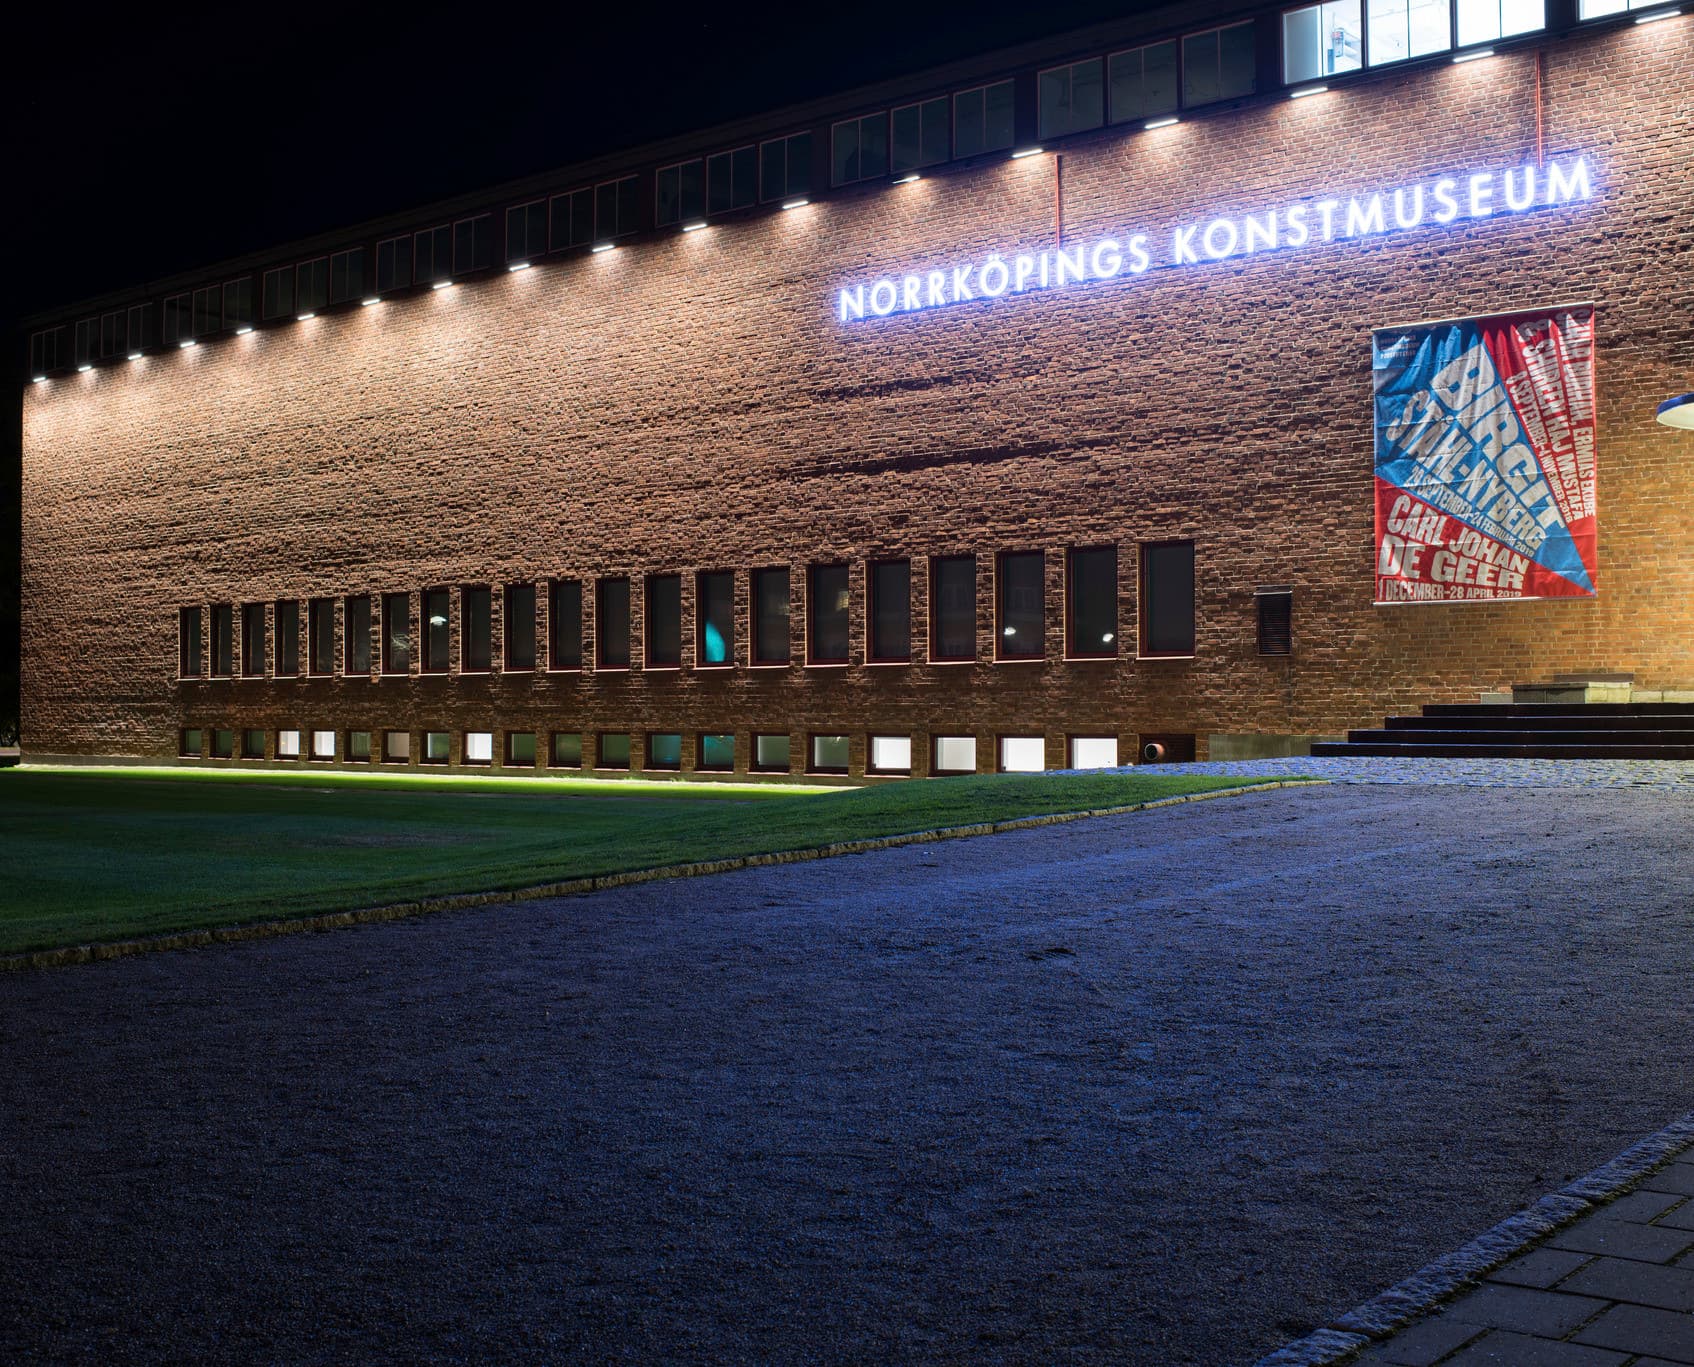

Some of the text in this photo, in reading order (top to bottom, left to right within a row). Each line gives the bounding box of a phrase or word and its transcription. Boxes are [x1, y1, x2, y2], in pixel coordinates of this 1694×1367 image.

[840, 160, 1591, 321] NORRKÖPINGS KONSTMUSEUM
[1522, 339, 1568, 418] SHIREEN
[1431, 343, 1566, 528] BIRGIT
[1545, 415, 1573, 452] HAJ
[1573, 426, 1595, 479] ERMIAS
[1386, 389, 1546, 550] STÅHL-NYBERG
[1540, 455, 1565, 501] NOVEMBER
[1556, 453, 1585, 520] MUSTAFA
[1581, 480, 1596, 517] EKUBE
[1378, 533, 1523, 590] DE GEER
[1387, 495, 1530, 574] CARL JOHAN
[1466, 587, 1495, 599] APRIL
